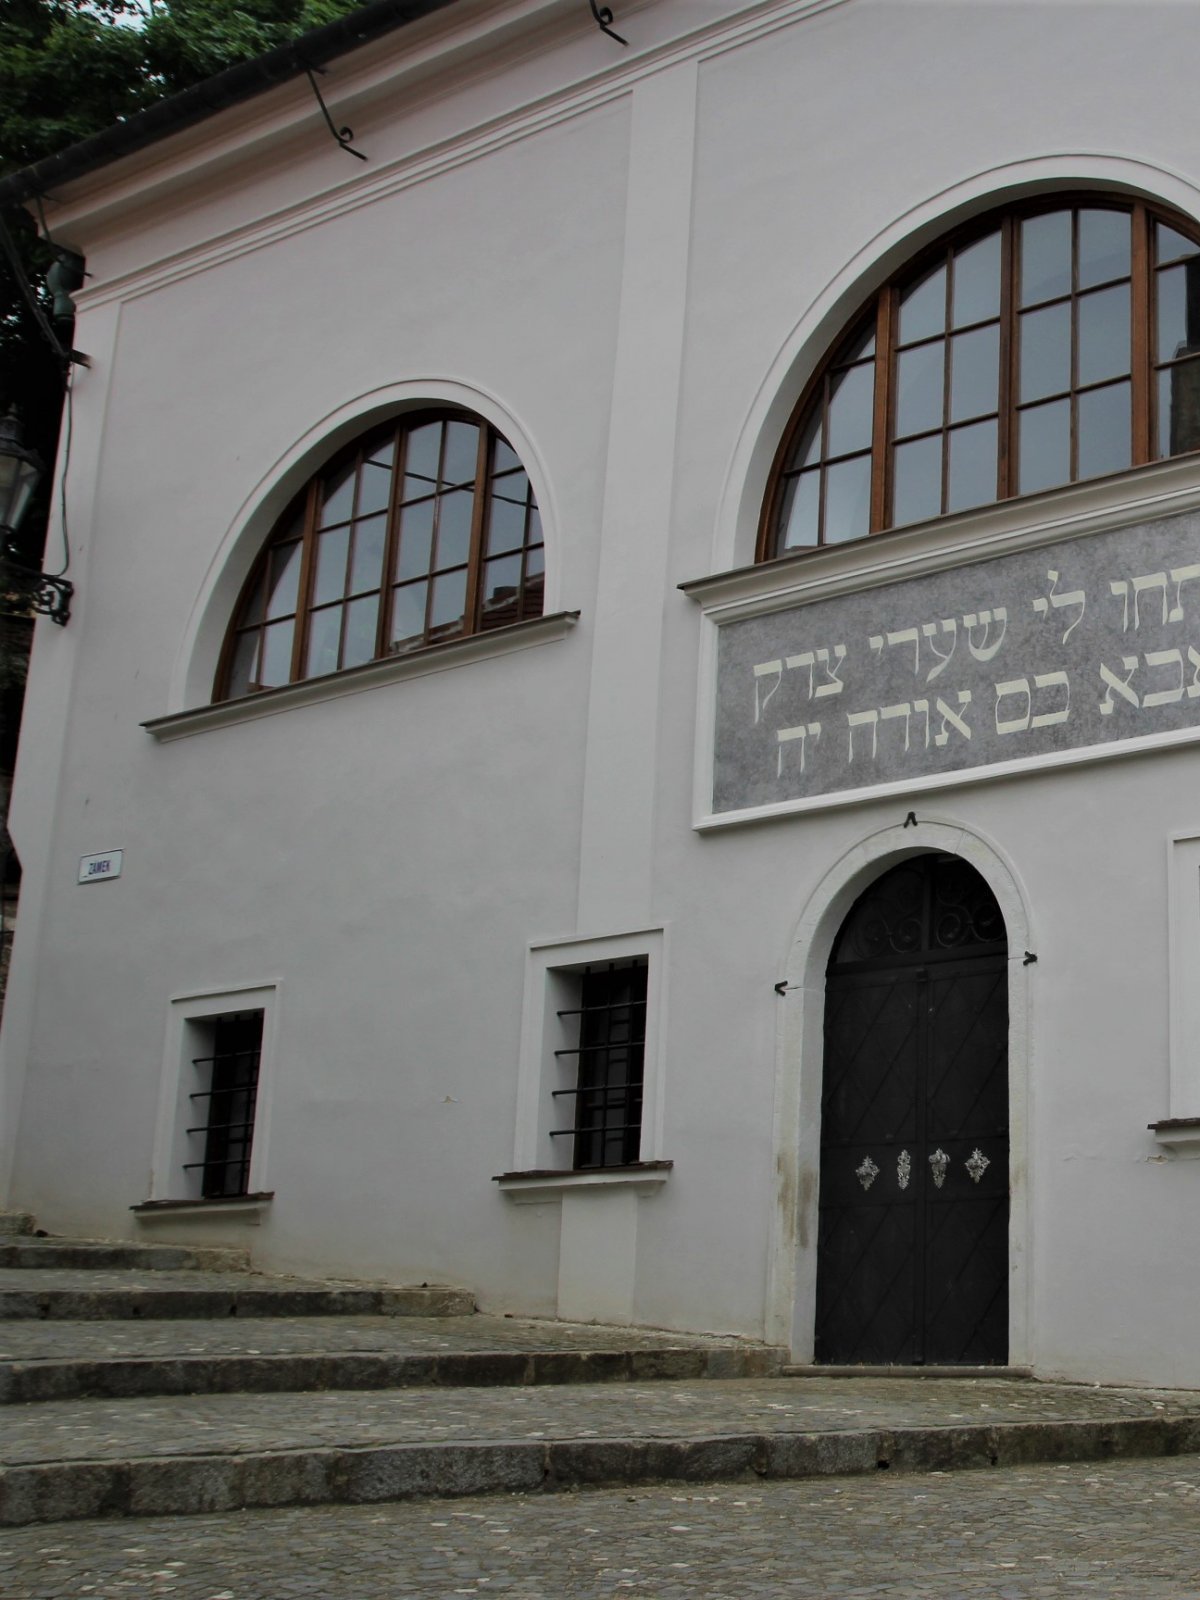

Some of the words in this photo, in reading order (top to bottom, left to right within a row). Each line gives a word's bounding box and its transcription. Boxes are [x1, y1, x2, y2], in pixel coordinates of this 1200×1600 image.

[868, 607, 1007, 682] שערי
[1033, 570, 1085, 645] לי
[753, 645, 846, 724] צדק
[994, 671, 1070, 735] בם
[777, 722, 821, 778] יה
[847, 690, 971, 764] אודה
